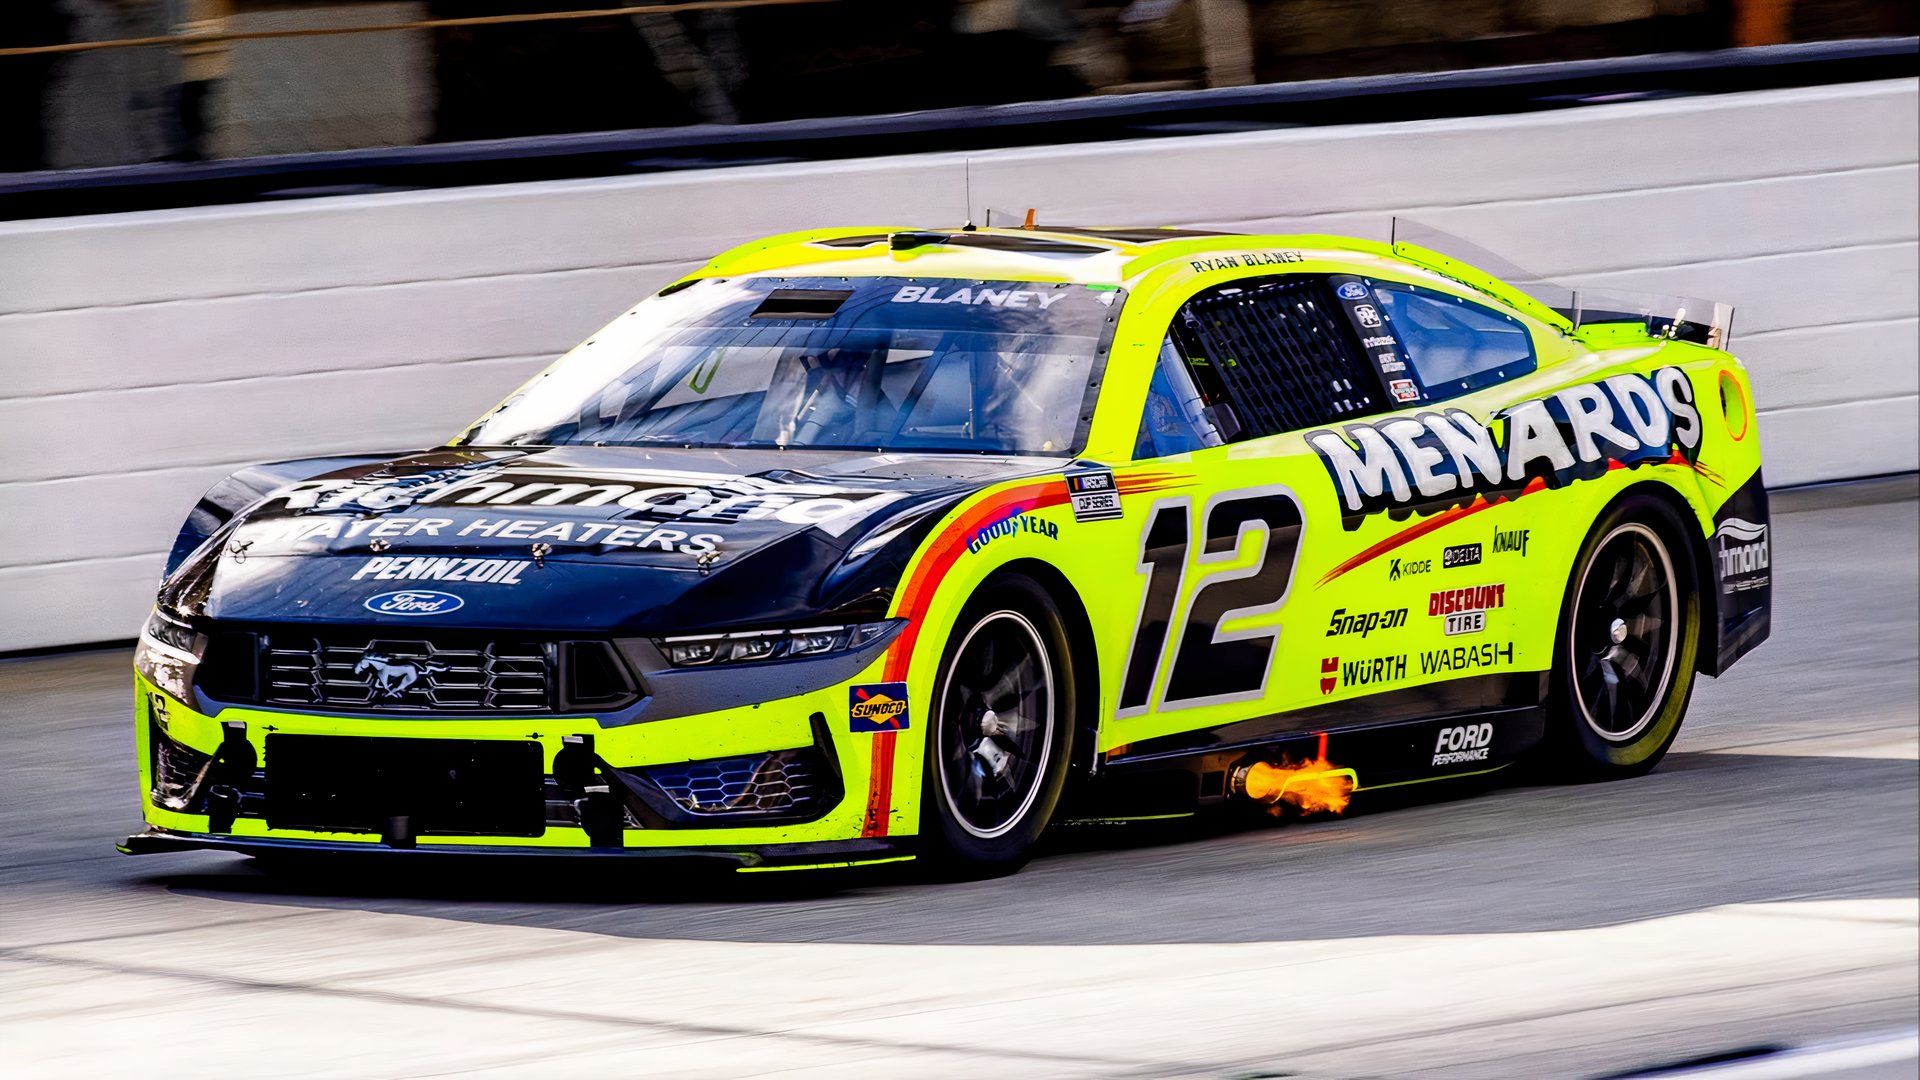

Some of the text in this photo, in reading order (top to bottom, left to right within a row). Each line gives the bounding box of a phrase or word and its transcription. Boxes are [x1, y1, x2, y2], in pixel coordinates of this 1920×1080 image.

[1190, 251, 1304, 273] RYAN BLANEY
[890, 285, 1067, 310] BLANEY
[1312, 365, 1702, 511] MENARDS
[457, 519, 724, 557] HEATERS
[966, 513, 1059, 555] GOODYEAR
[1492, 525, 1530, 557] KNAUF
[1402, 559, 1432, 576] KIDDE
[1452, 547, 1480, 564] DELTA
[350, 557, 532, 585] PENNZOIL
[379, 592, 448, 612] Ford
[1114, 485, 1306, 720] 12
[1428, 584, 1505, 616] DISCOUNT
[1326, 608, 1408, 638] Snap-on
[1448, 614, 1482, 634] TIRE
[1420, 642, 1513, 674] WABASH
[854, 702, 904, 716] SUNOCO
[1435, 722, 1493, 753] FORD
[1432, 747, 1490, 766] PERFORMANCE
